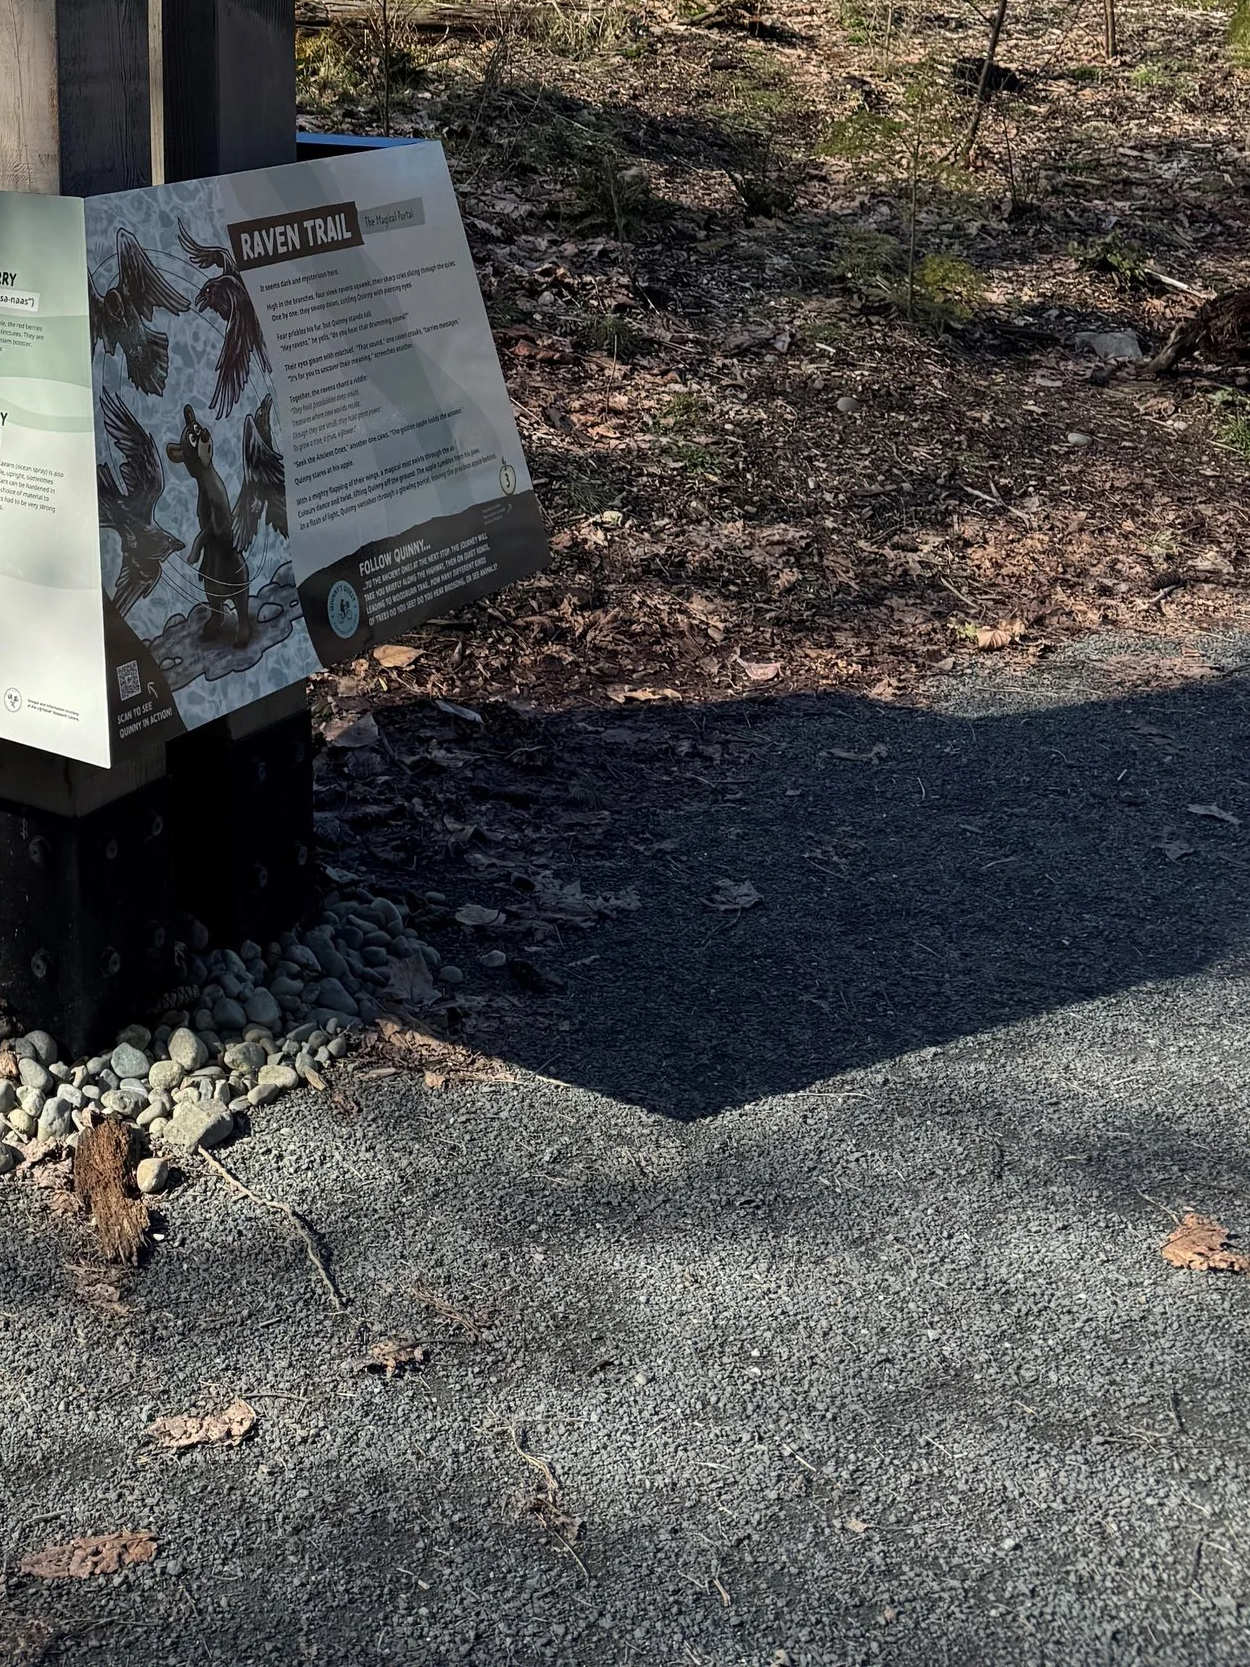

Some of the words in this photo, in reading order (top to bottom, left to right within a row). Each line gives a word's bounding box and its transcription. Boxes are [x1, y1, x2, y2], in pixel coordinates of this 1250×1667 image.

[364, 215, 375, 228] The
[375, 211, 397, 228] Magical
[397, 207, 414, 222] Portal
[241, 224, 301, 261] RAVEN
[303, 213, 352, 246] TRAIL
[503, 471, 511, 488] 3
[359, 551, 392, 577] FOLLOW
[117, 710, 132, 725] SCAN
[133, 706, 141, 717] TO
[142, 701, 152, 713] SEE
[119, 722, 141, 739] QUINNY
[142, 717, 149, 728] IN
